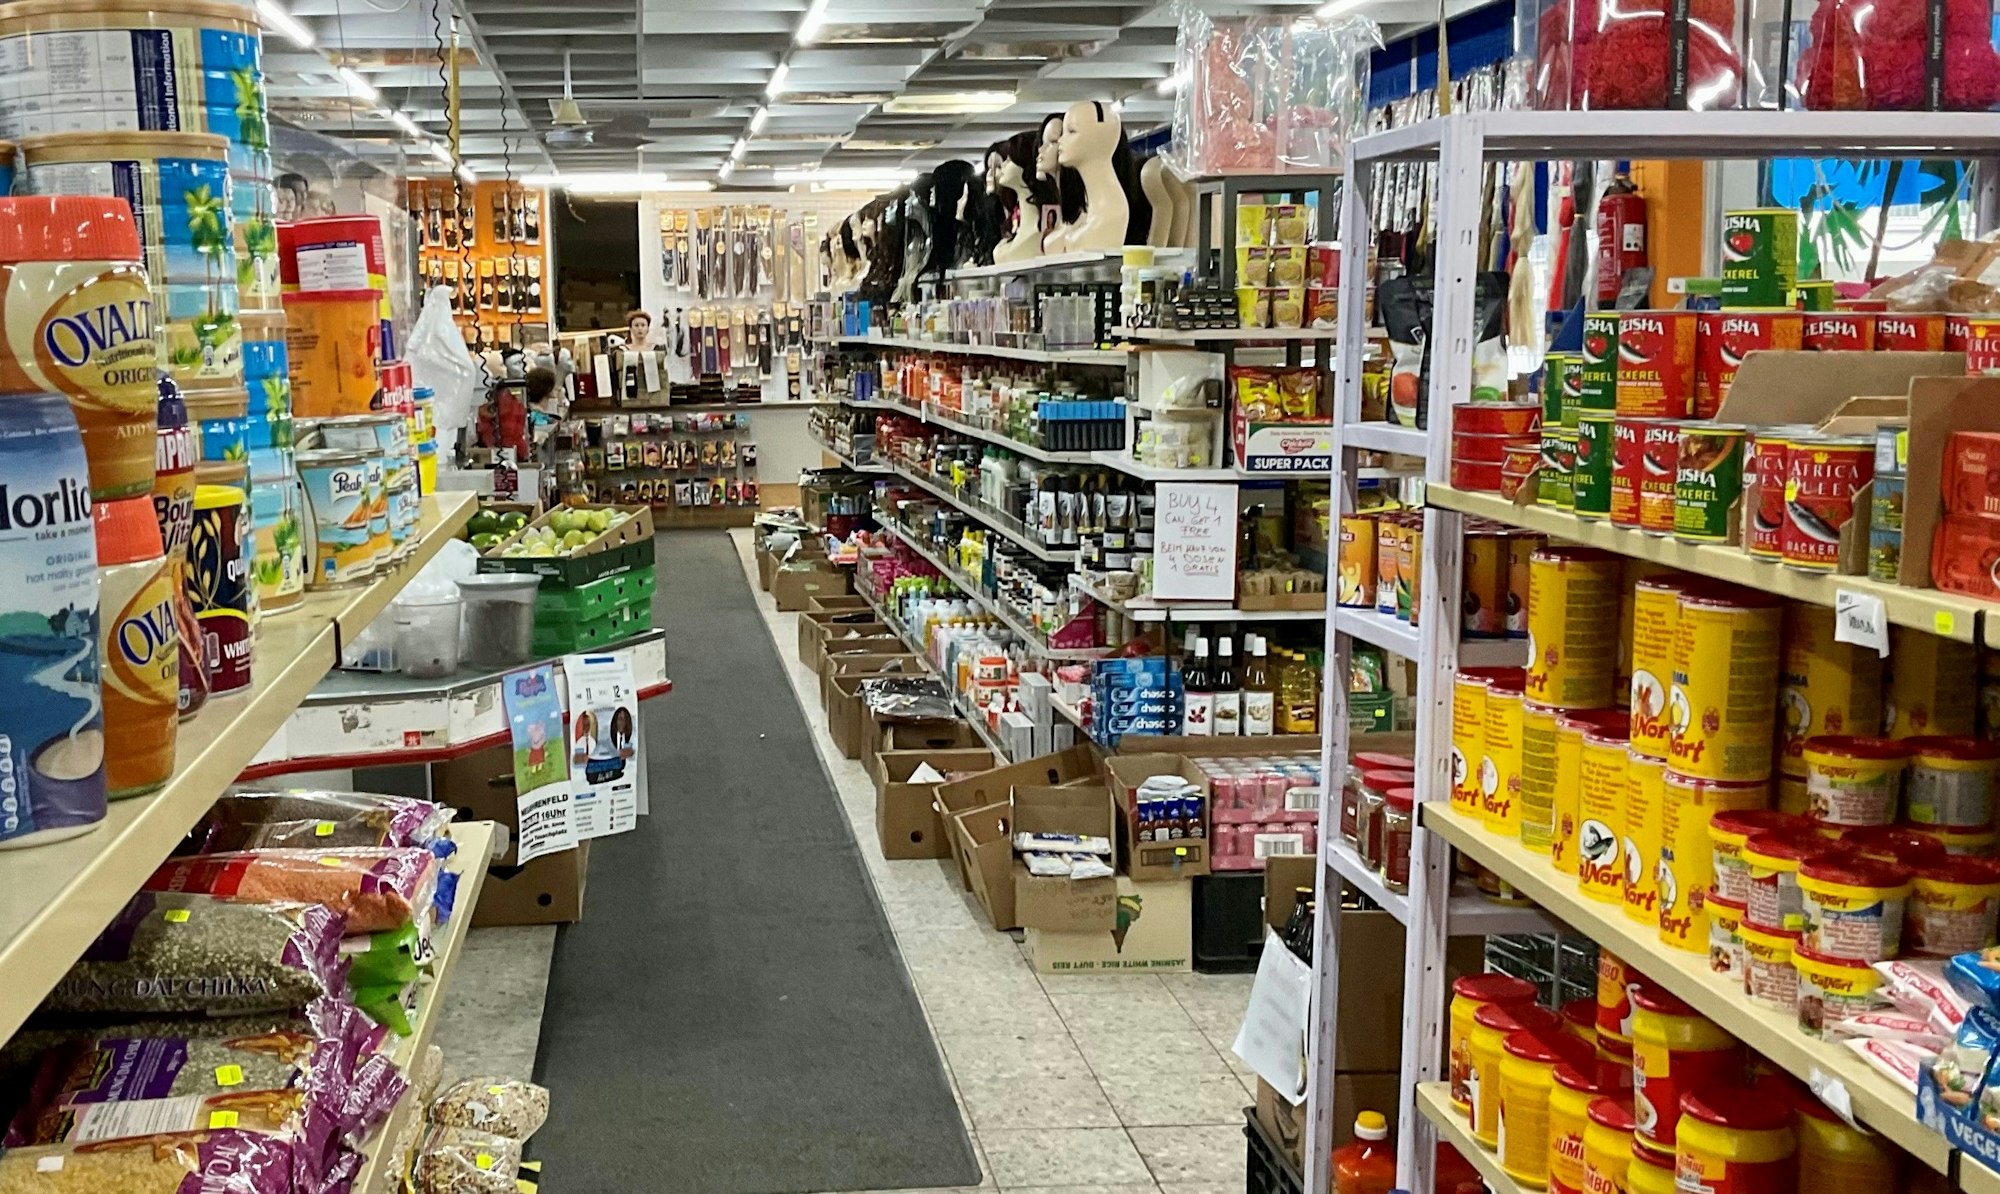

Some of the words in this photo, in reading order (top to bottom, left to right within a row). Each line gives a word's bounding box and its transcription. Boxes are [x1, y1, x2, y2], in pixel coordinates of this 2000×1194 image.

[160, 32, 174, 96] Information
[1254, 457, 1291, 470] SUPER
[1294, 458, 1329, 470] PACK
[1792, 459, 1859, 479] AFRICA
[334, 472, 362, 494] Peak
[1169, 492, 1200, 515] BUY
[1206, 496, 1218, 515] 4
[1165, 512, 1185, 524] CAN
[1213, 516, 1221, 526] 1
[35, 529, 58, 541] take
[60, 530, 66, 538] a
[1161, 541, 1182, 553] BEIM
[613, 685, 621, 698] 12
[1102, 961, 1120, 969] RICE
[1123, 960, 1149, 968] WHITE
[1151, 959, 1186, 968] JASMINE
[134, 976, 178, 997] DAL
[185, 977, 268, 997] CHILKA
